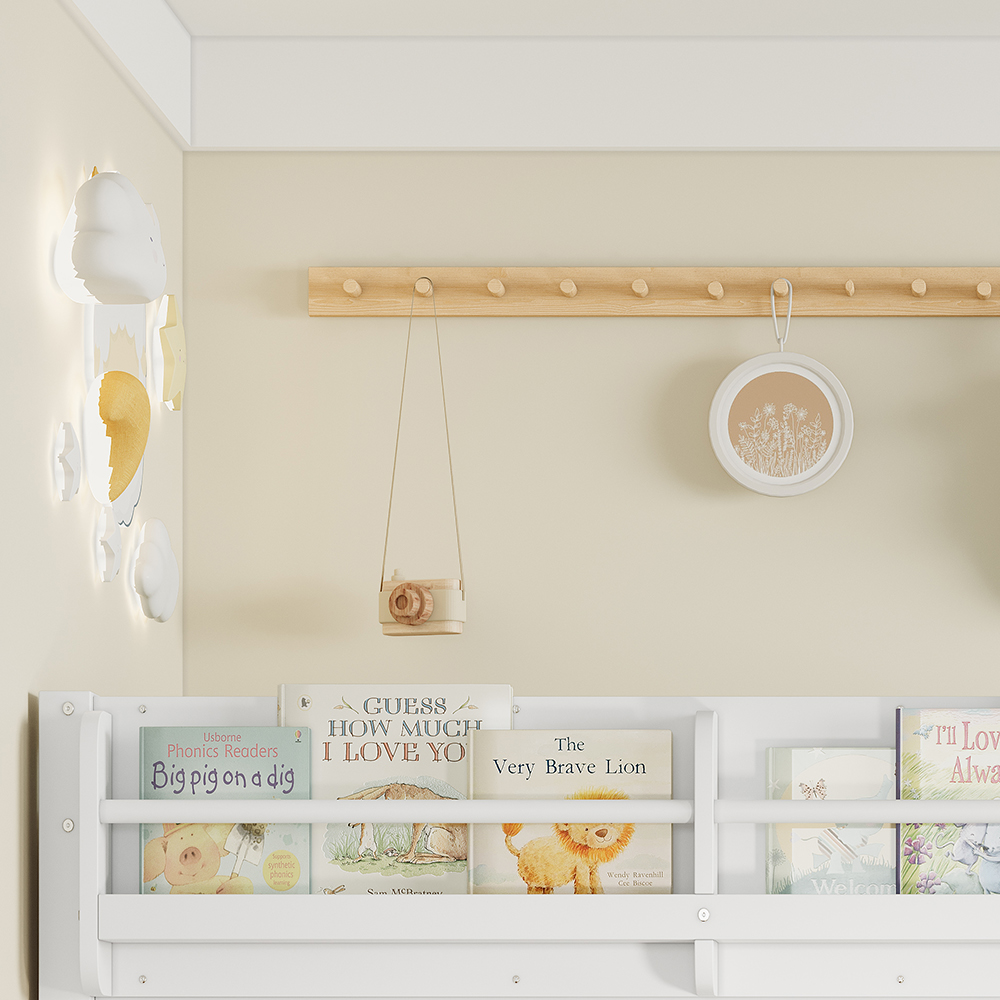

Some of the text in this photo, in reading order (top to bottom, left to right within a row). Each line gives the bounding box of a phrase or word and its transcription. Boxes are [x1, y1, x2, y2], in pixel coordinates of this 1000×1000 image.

[363, 696, 447, 715] GUESS
[203, 732, 242, 742] Usborne
[327, 719, 483, 738] HOW MUCH
[936, 725, 957, 745] I'll
[167, 743, 279, 758] Phonics Readers
[322, 741, 468, 762] I LOVE YO
[554, 736, 585, 752] The
[151, 760, 295, 795] Big pig on a dig
[493, 758, 647, 781] Very Brave Lion
[267, 861, 296, 870] synthetic
[269, 870, 294, 880] phonics
[607, 872, 629, 880] Wendy
